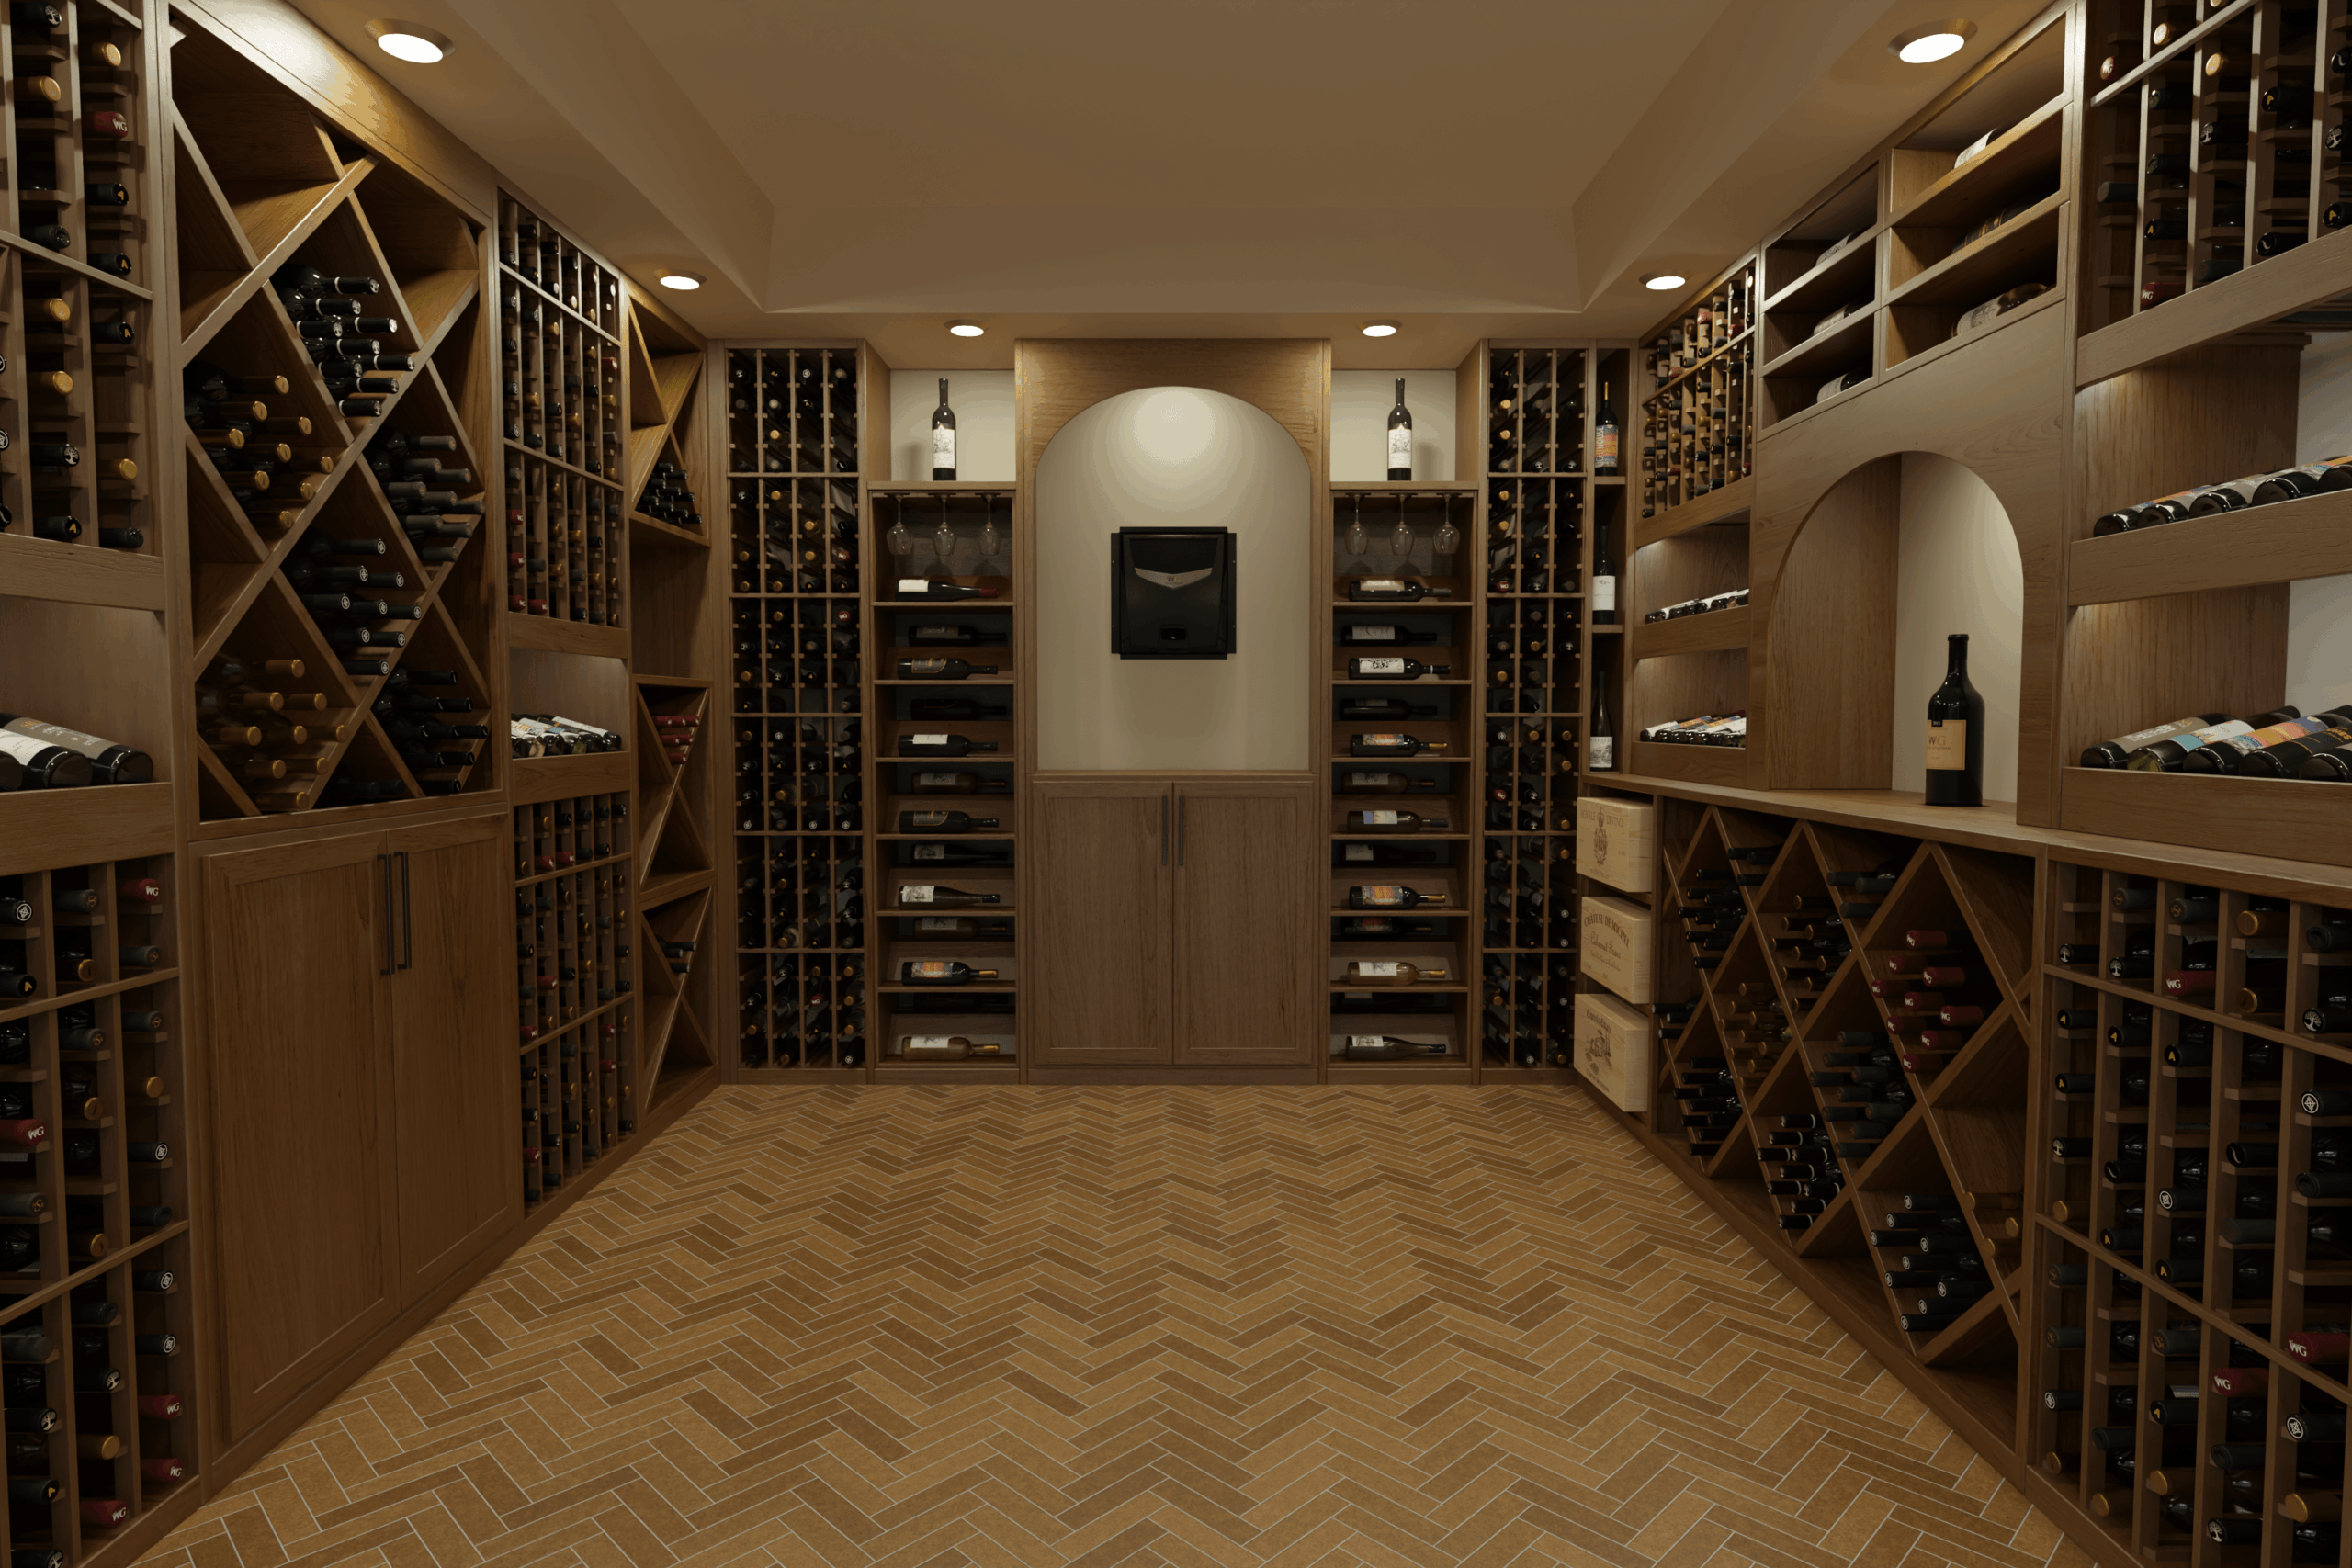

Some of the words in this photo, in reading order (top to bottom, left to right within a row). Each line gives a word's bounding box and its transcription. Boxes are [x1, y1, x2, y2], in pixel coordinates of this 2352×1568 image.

[2101, 62, 2112, 73] WG
[113, 118, 127, 131] WG
[2142, 289, 2153, 299] WG
[1928, 736, 1946, 745] WG
[146, 886, 158, 896] WG
[1605, 915, 1611, 929] DE
[2166, 979, 2181, 988] WG
[28, 1126, 44, 1139] WG
[2290, 1339, 2306, 1356] WG
[2214, 1375, 2230, 1390] WG
[167, 1402, 179, 1414] WG
[171, 1466, 182, 1476] WG
[113, 1506, 126, 1521] WG
